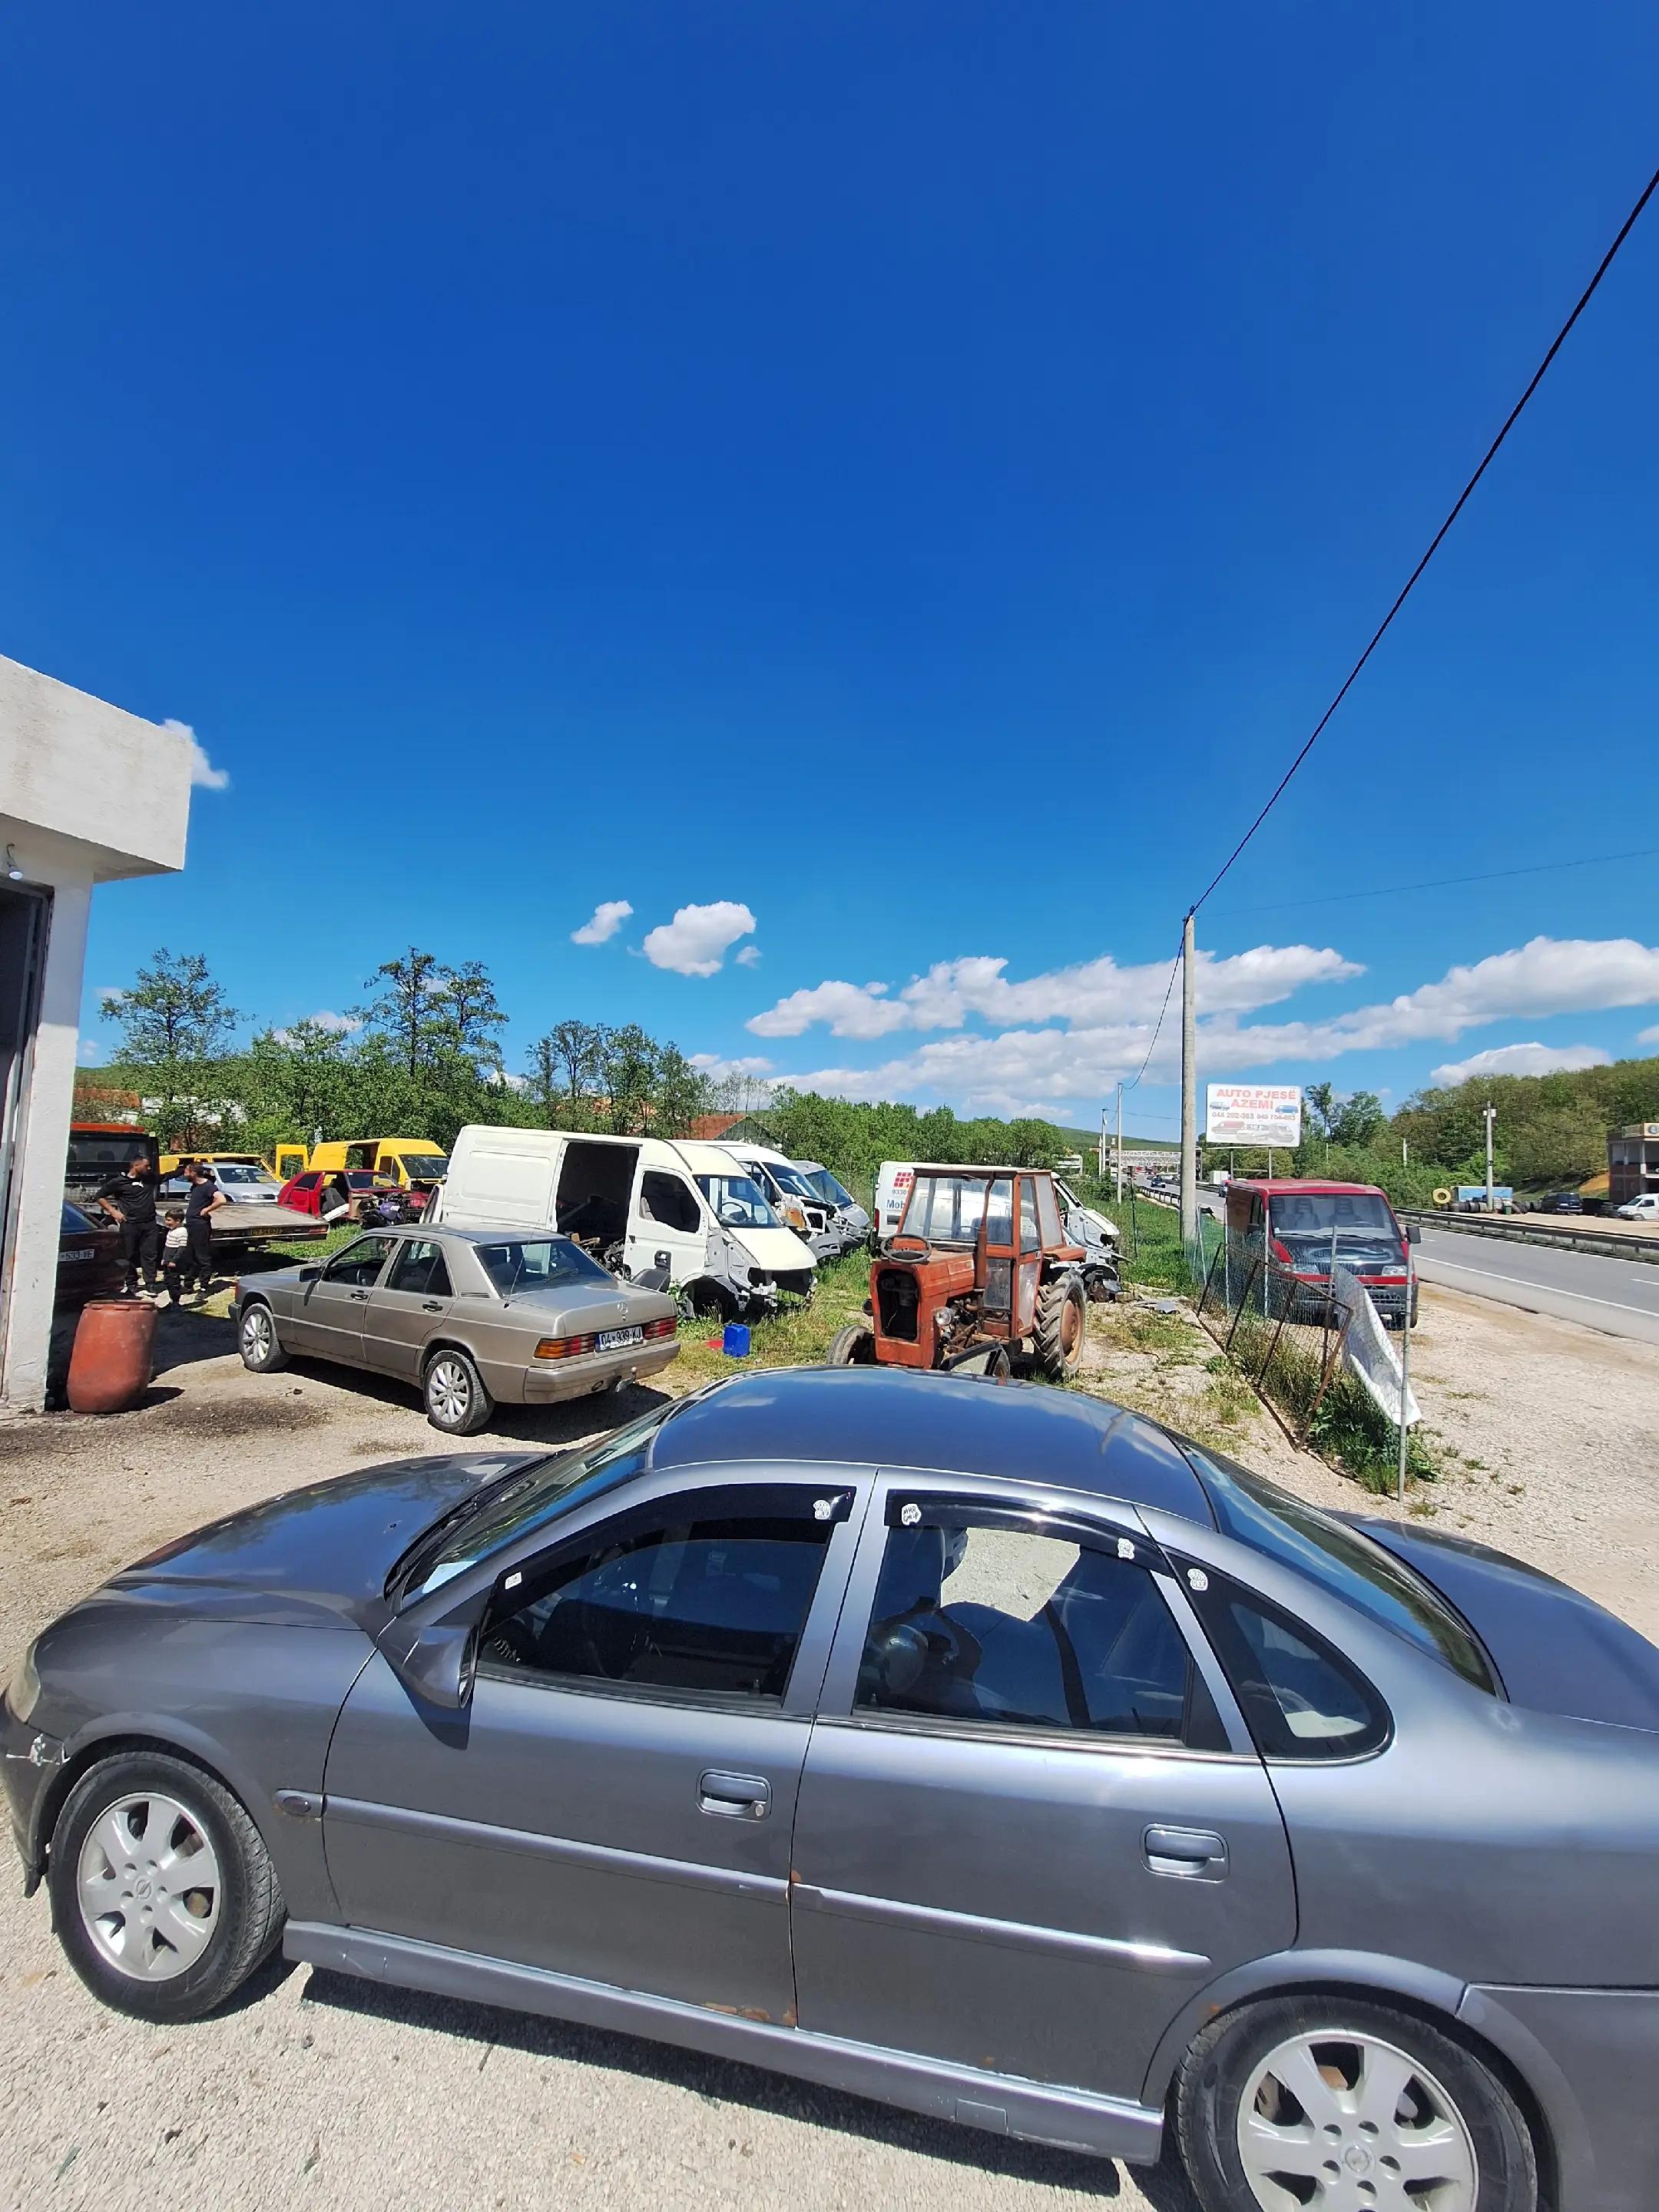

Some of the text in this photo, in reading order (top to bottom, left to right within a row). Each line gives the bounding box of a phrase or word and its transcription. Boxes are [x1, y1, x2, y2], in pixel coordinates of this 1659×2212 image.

[1217, 1089, 1296, 1100] AUTO PJESË
[1230, 1099, 1273, 1109] AZEMI
